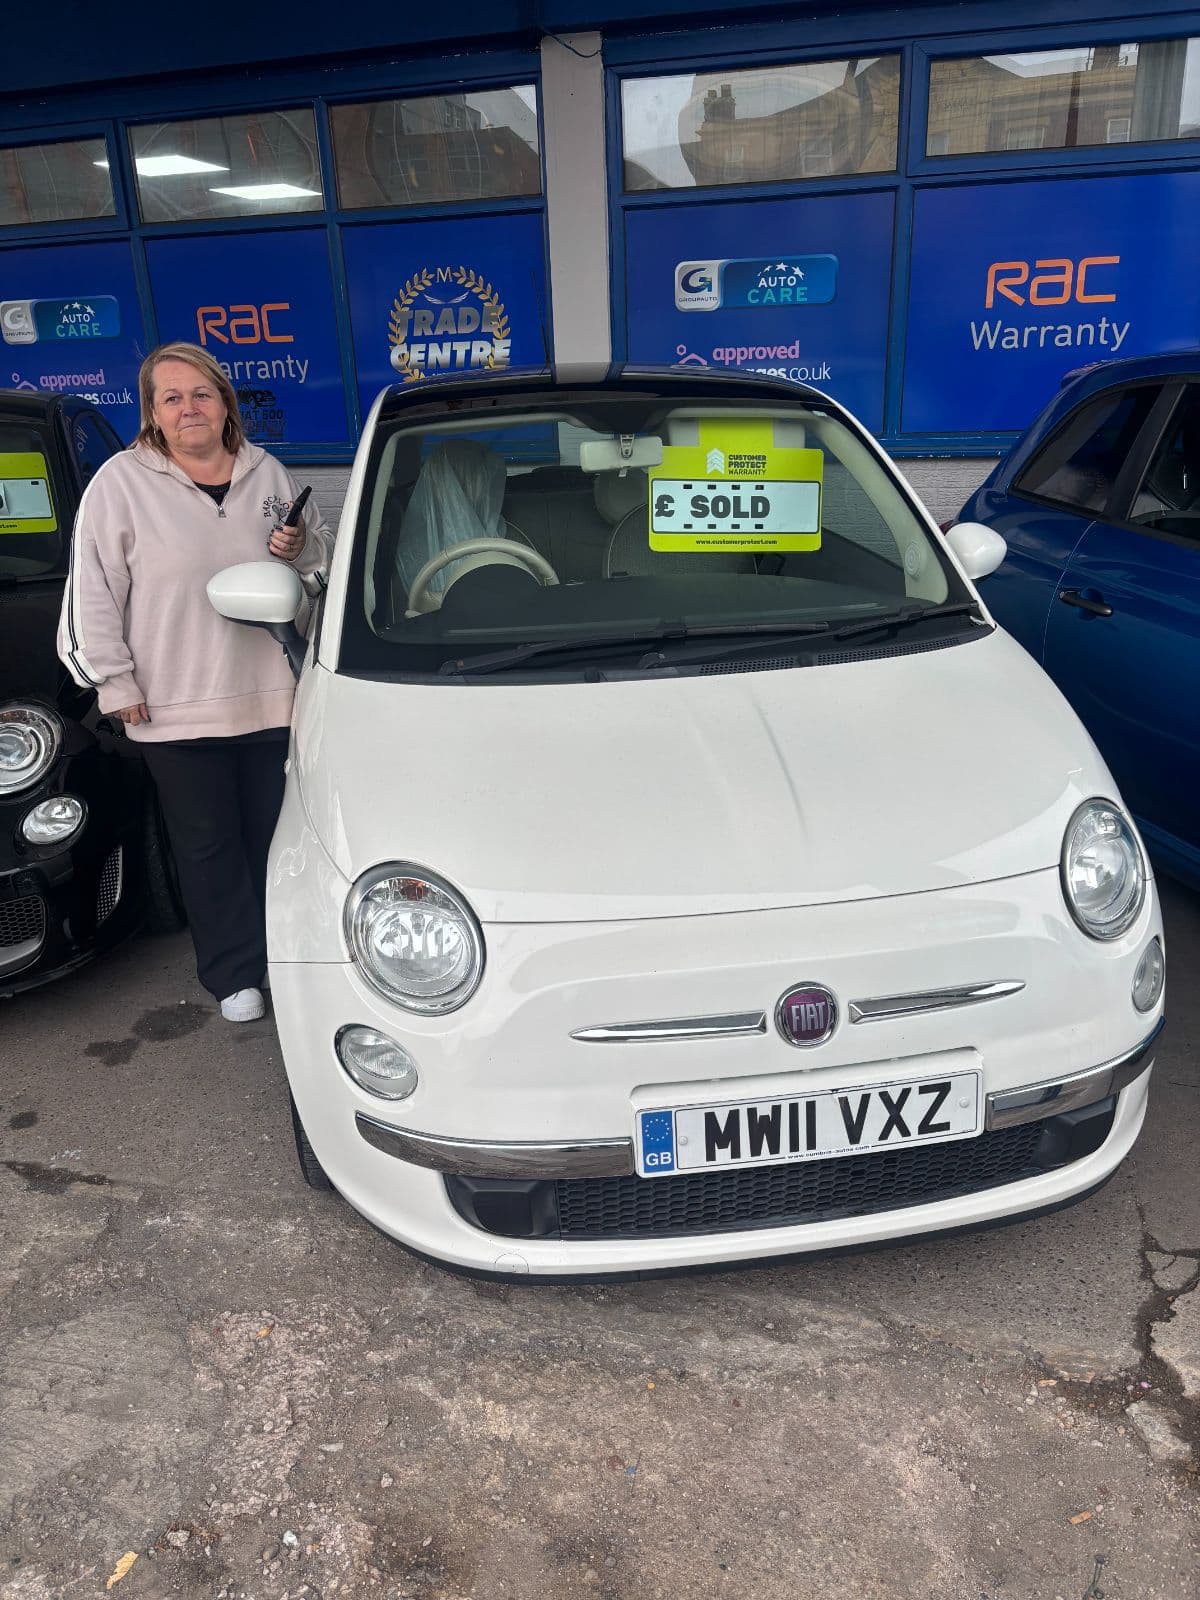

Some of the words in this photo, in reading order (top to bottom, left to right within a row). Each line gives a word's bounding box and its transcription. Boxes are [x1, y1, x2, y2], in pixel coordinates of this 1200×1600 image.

[435, 266, 453, 283] M
[758, 276, 797, 288] AUTO
[747, 287, 808, 304] CARE
[61, 313, 91, 324] AUTO
[395, 305, 501, 337] TRADE
[55, 323, 102, 338] CARE
[970, 316, 1131, 352] Warranty
[390, 338, 512, 371] CENTRE
[712, 340, 801, 365] approved
[39, 369, 106, 391] approved
[214, 353, 309, 384] arranty
[728, 468, 767, 476] WARRANTY
[654, 494, 675, 518] £
[690, 494, 771, 519] SOLD
[791, 1001, 828, 1032] FIAT
[703, 1100, 817, 1162] MW11
[836, 1081, 952, 1145] VXZ
[645, 1152, 672, 1167] GB
